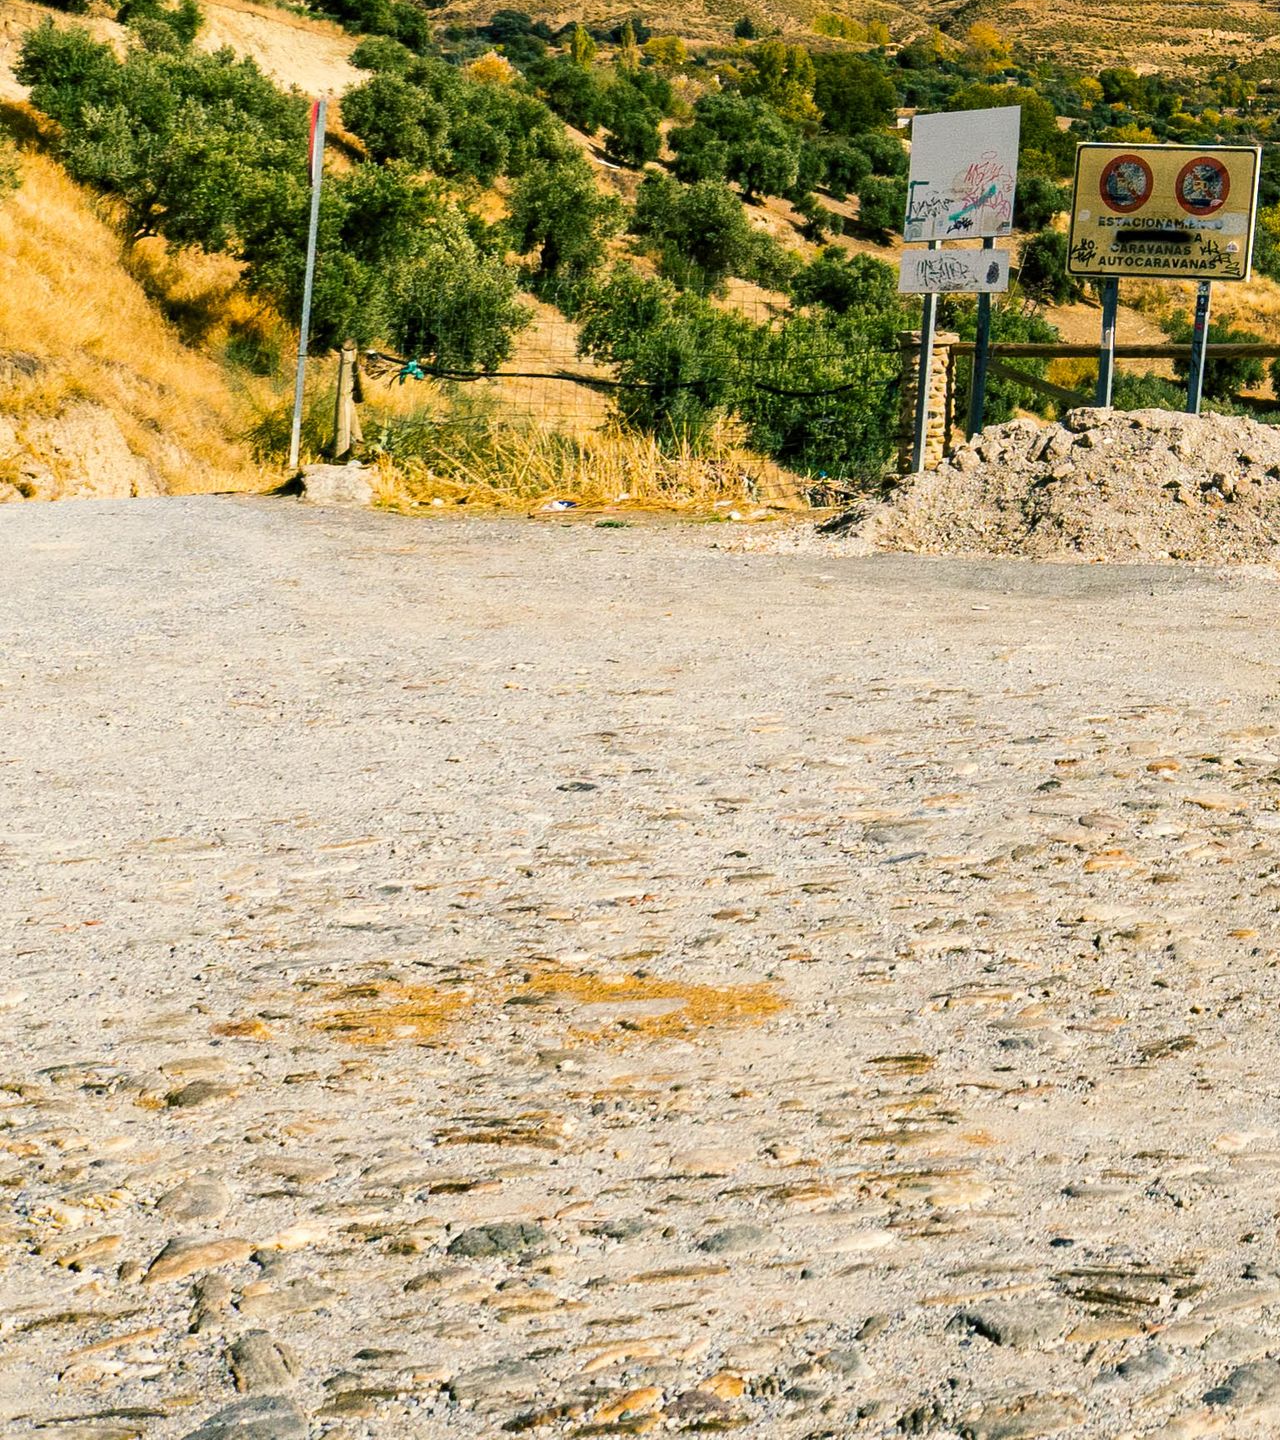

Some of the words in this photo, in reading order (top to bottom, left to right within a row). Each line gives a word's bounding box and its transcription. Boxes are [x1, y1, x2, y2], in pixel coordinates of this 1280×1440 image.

[1194, 232, 1203, 243] A
[1111, 243, 1192, 256] CARAVANAS
[1098, 256, 1217, 270] AUTOCARAVANAS
